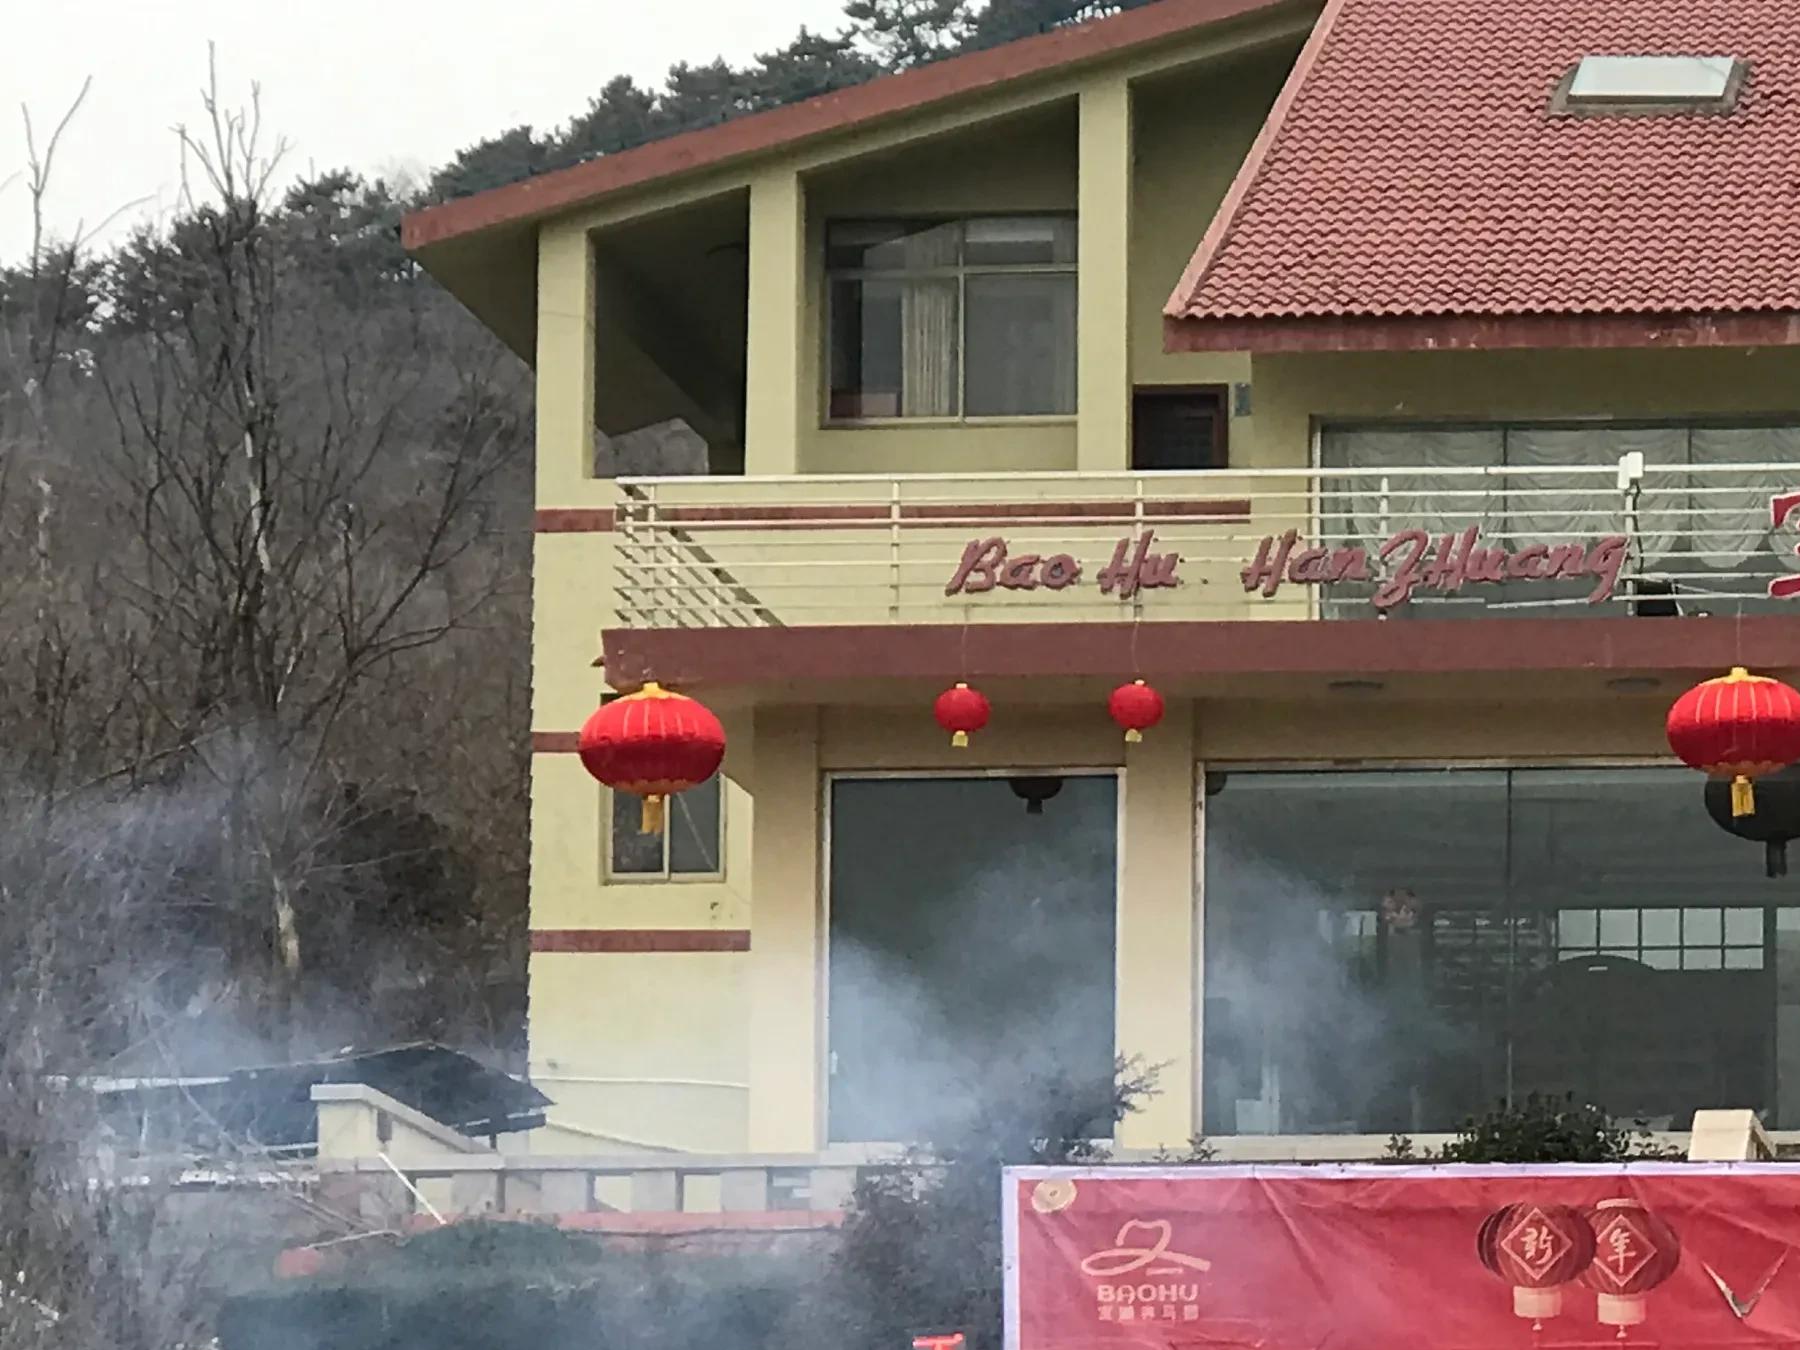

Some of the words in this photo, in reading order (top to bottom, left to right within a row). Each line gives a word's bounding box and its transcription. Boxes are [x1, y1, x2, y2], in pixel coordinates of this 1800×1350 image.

[945, 536, 1082, 596] Bao
[1096, 529, 1184, 596] Hu
[1097, 1284, 1199, 1304] BAOHU
